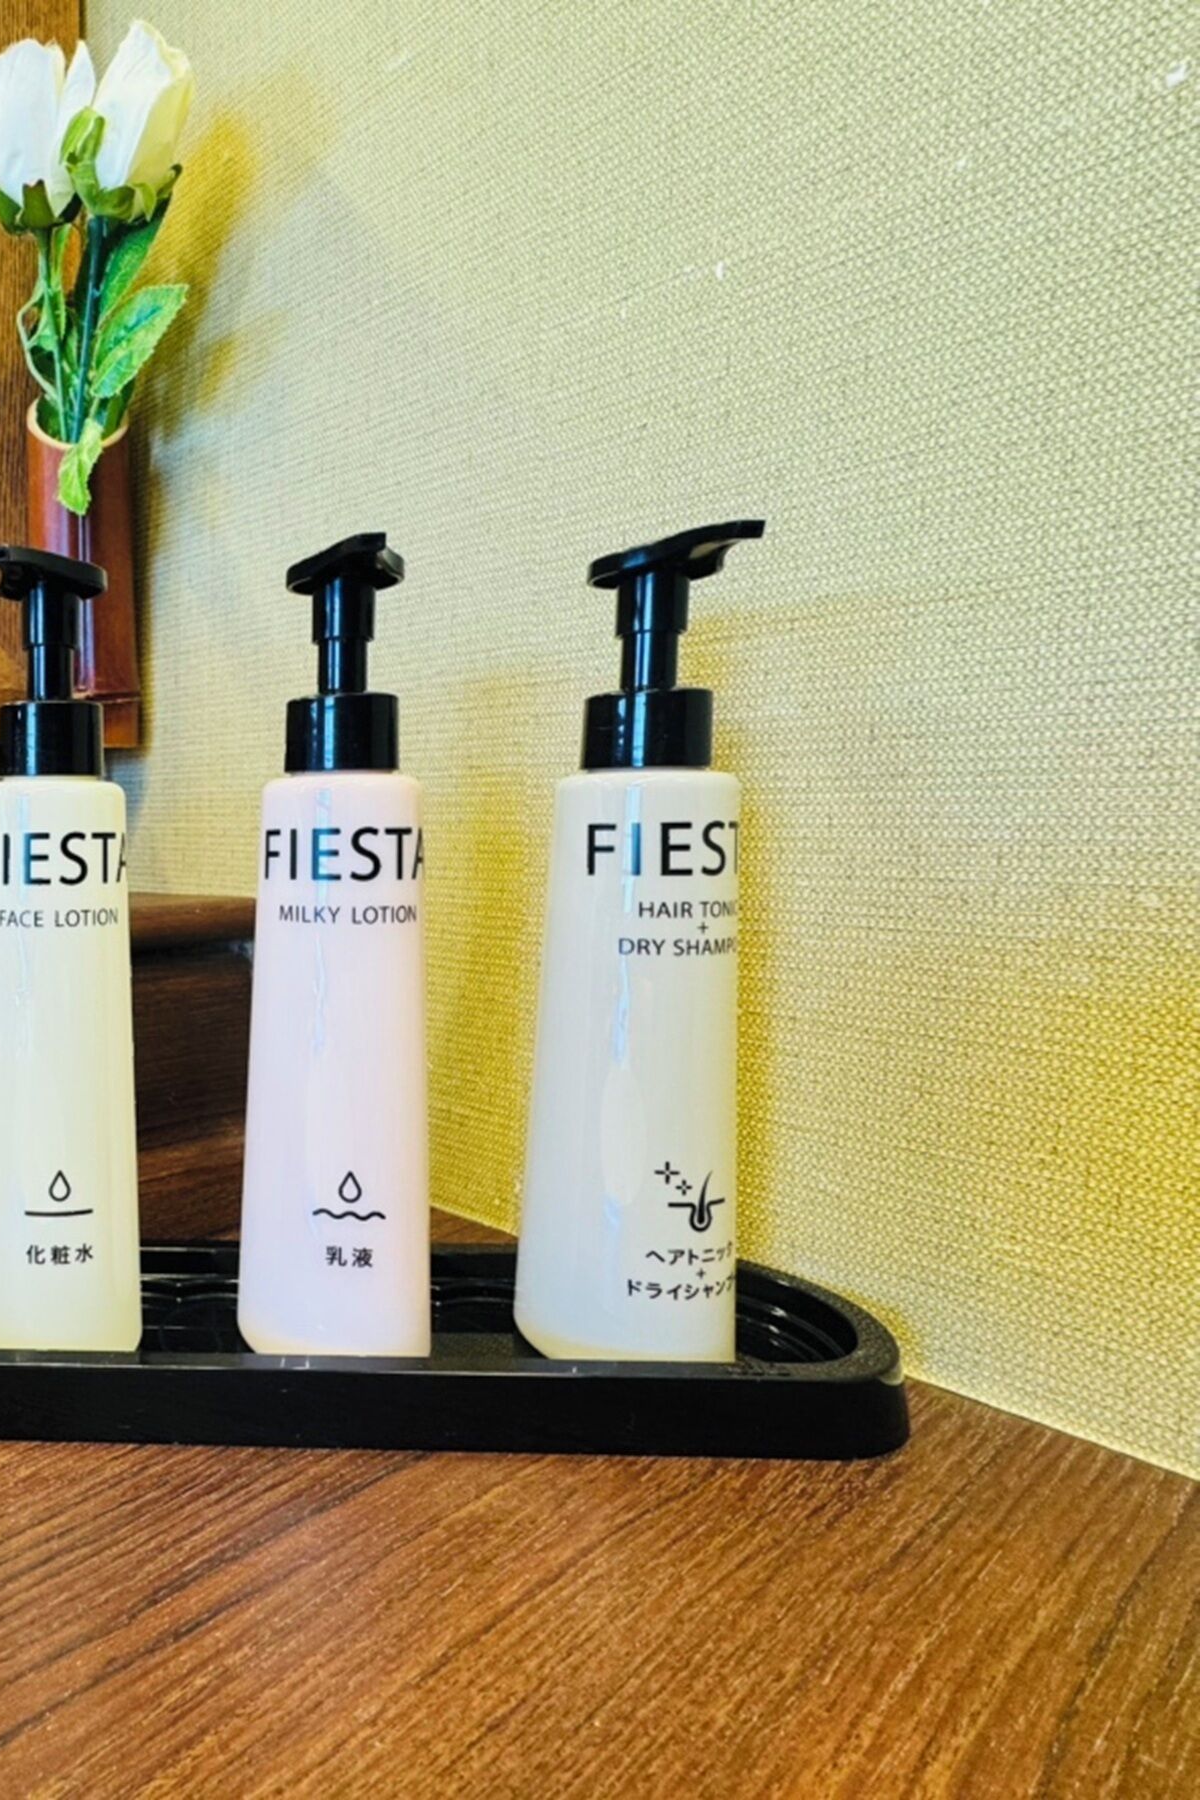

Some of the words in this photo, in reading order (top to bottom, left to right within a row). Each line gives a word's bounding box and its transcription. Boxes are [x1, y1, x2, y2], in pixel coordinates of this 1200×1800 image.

[54, 908, 119, 927] LOTION
[279, 905, 340, 924] MILKY
[352, 905, 417, 925] LOTION
[638, 901, 693, 918] HAIR
[699, 900, 737, 918] TON
[618, 938, 666, 956] DRY
[26, 1243, 93, 1265] 化粧水
[325, 1246, 373, 1267] 乳液
